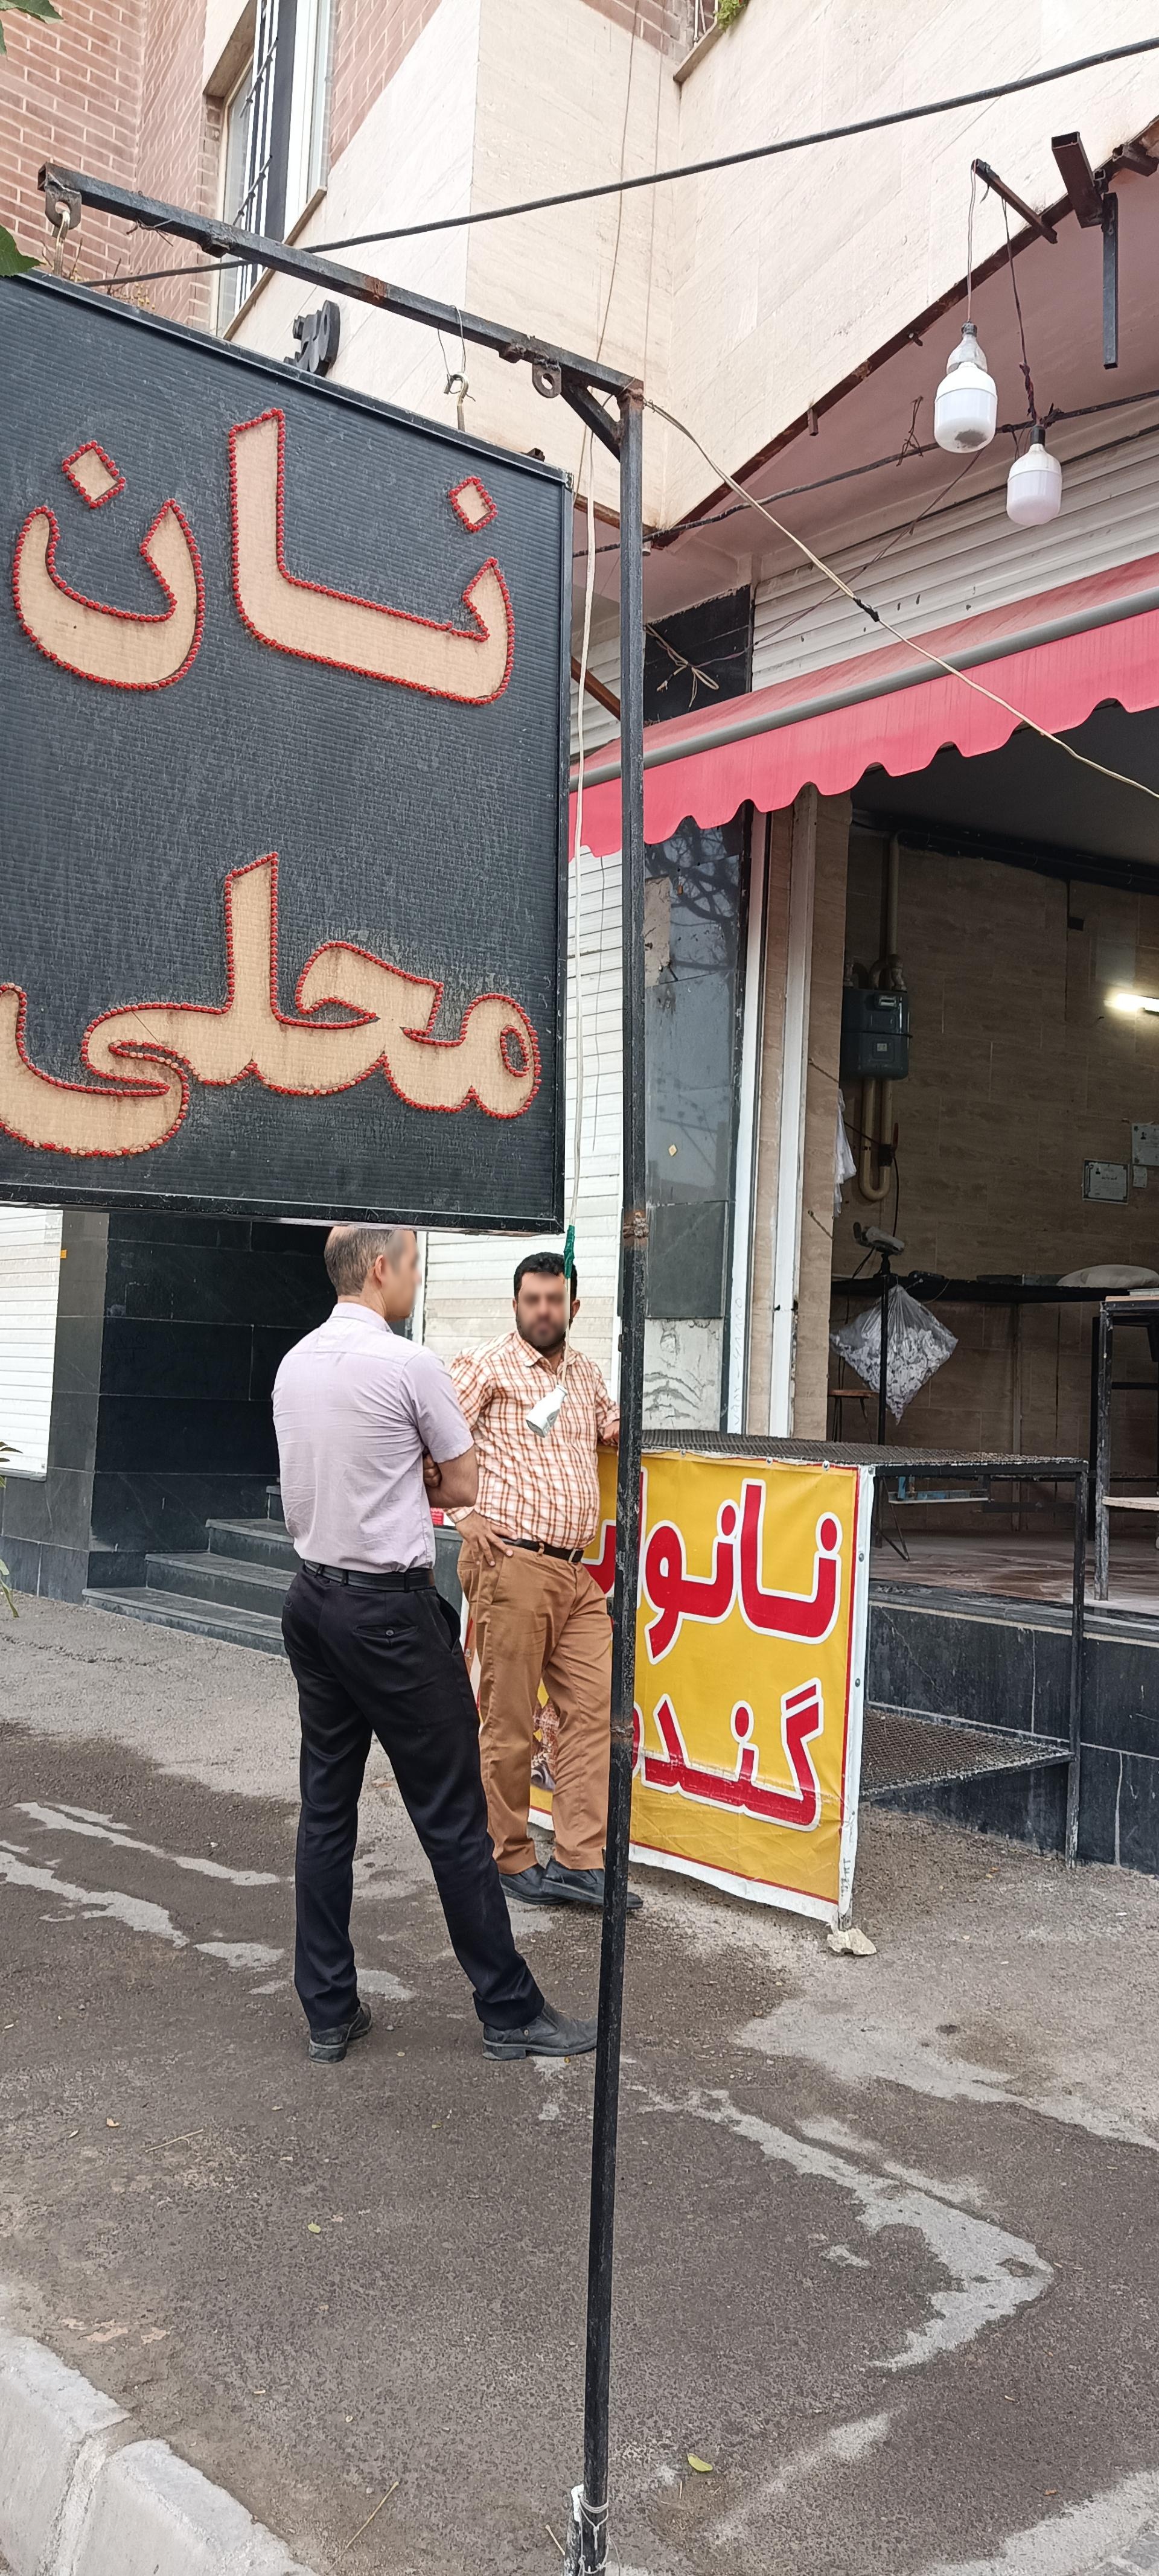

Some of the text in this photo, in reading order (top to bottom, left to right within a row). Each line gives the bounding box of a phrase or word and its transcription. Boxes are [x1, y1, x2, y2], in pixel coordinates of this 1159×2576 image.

[13, 408, 514, 705] نان
[0, 852, 541, 1158] محلی
[581, 1467, 843, 1664] نانو
[632, 1677, 823, 1832] گند
